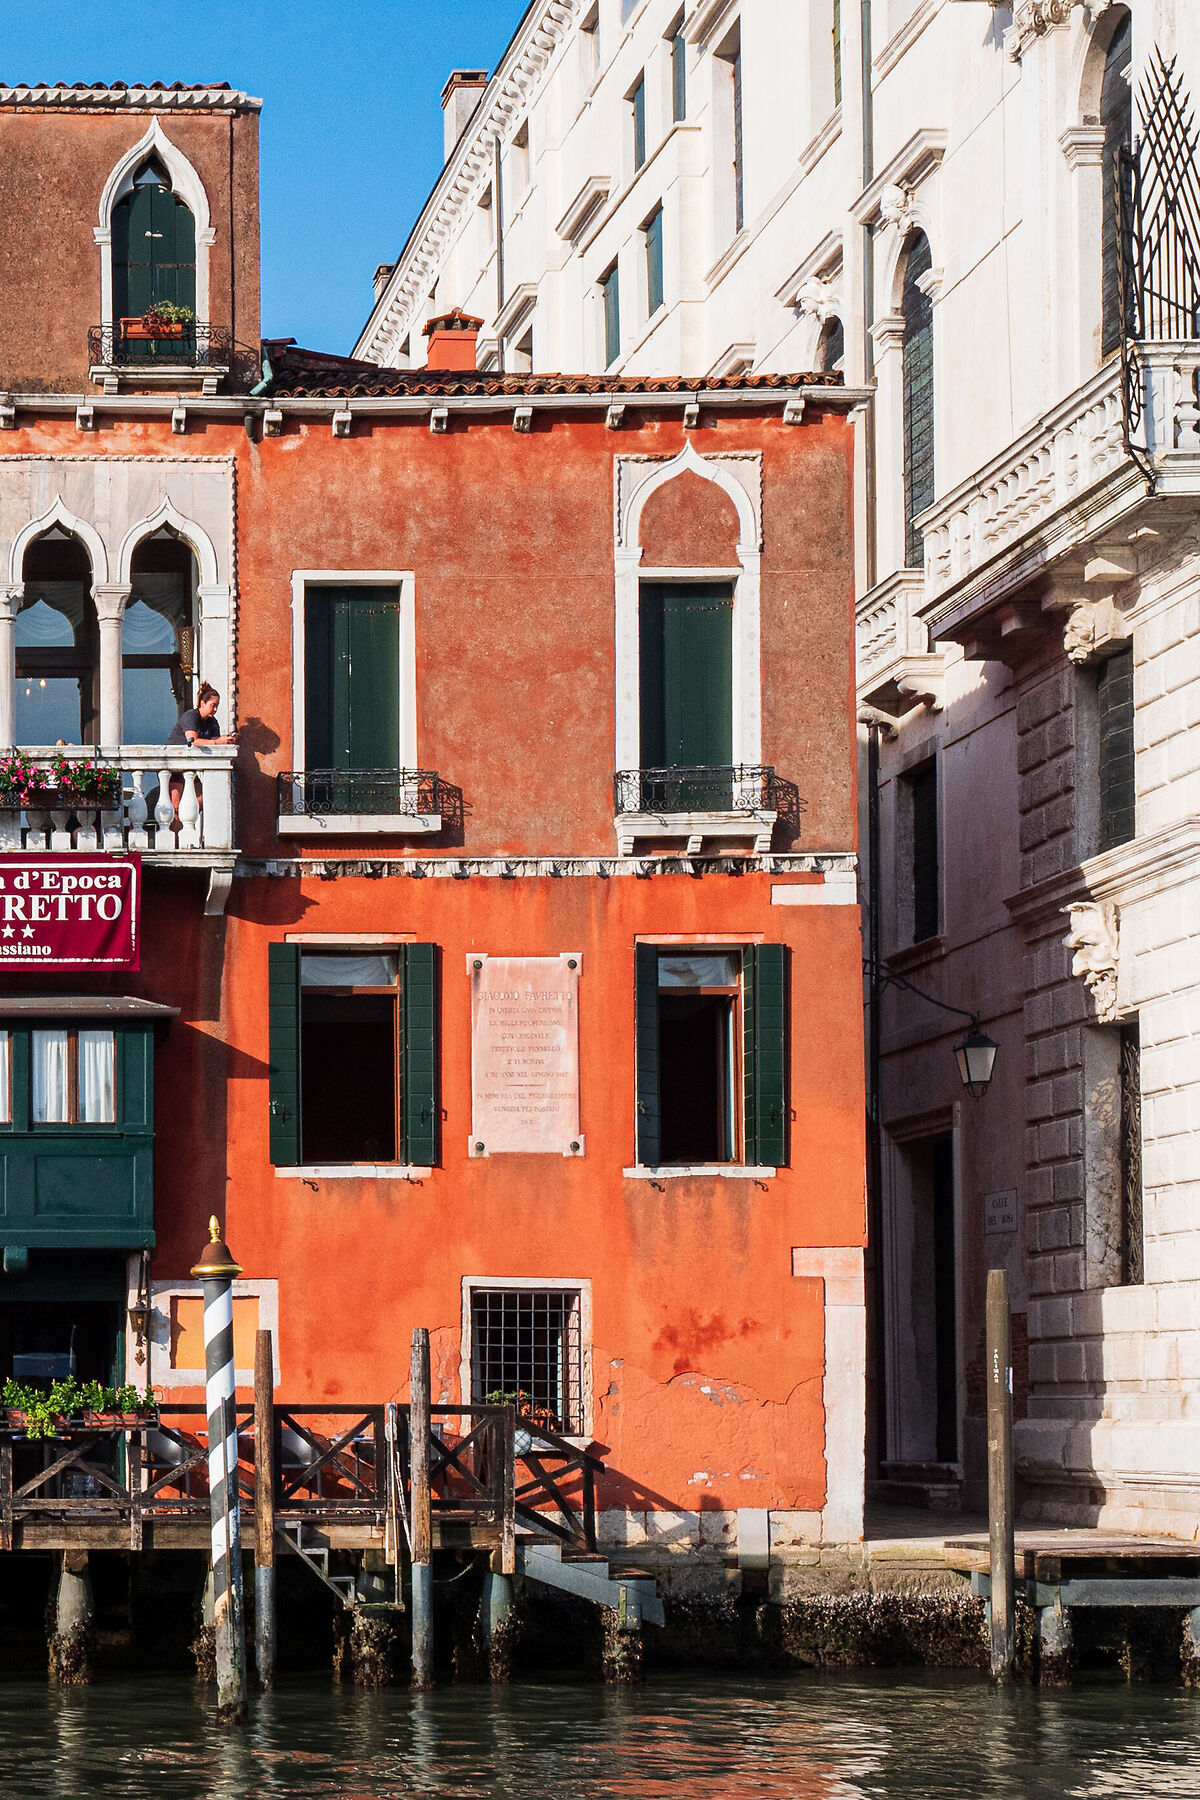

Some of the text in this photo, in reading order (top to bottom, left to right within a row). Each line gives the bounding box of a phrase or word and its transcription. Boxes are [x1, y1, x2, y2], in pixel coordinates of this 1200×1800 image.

[13, 871, 122, 894] d’Epoca
[478, 991, 572, 1001] GIACOMO FAVRETTO
